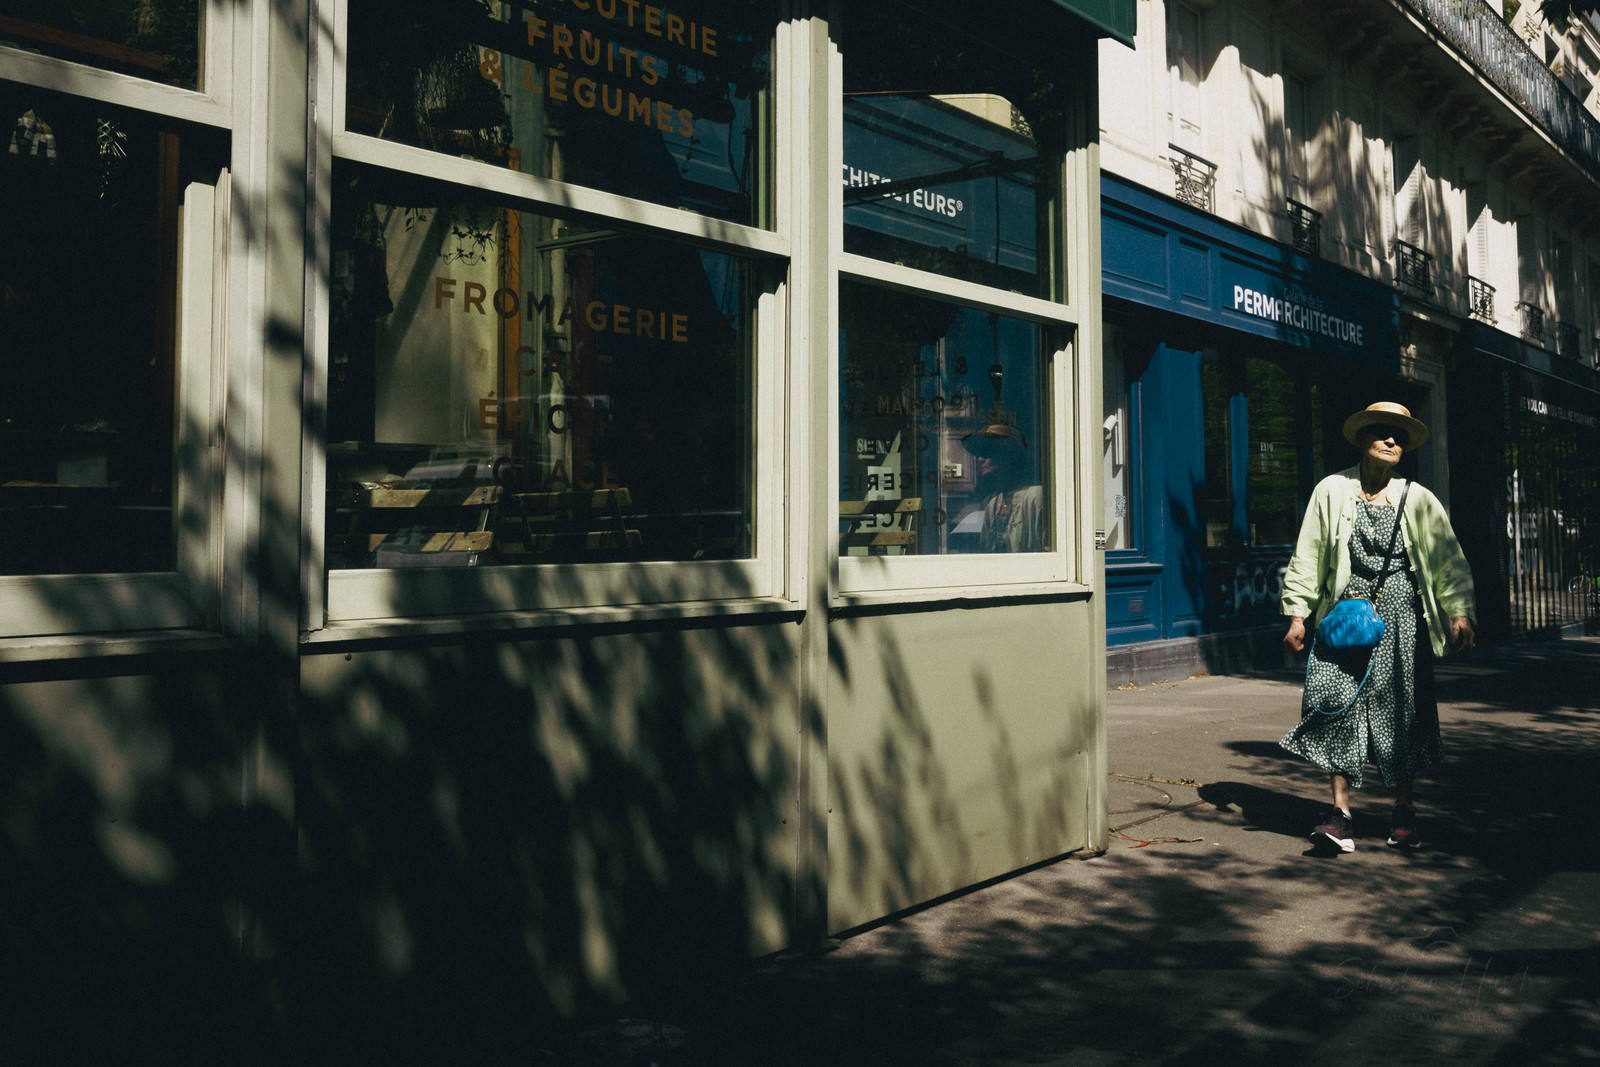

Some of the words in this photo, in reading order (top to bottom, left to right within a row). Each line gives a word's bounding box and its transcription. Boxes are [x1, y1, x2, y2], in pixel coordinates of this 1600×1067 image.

[528, 15, 659, 86] FRUITS
[480, 47, 502, 82] &
[525, 60, 694, 138] LÉGUMES
[435, 277, 689, 343] FROMAGERIE
[1234, 284, 1364, 346] PERMARCHITECTURE
